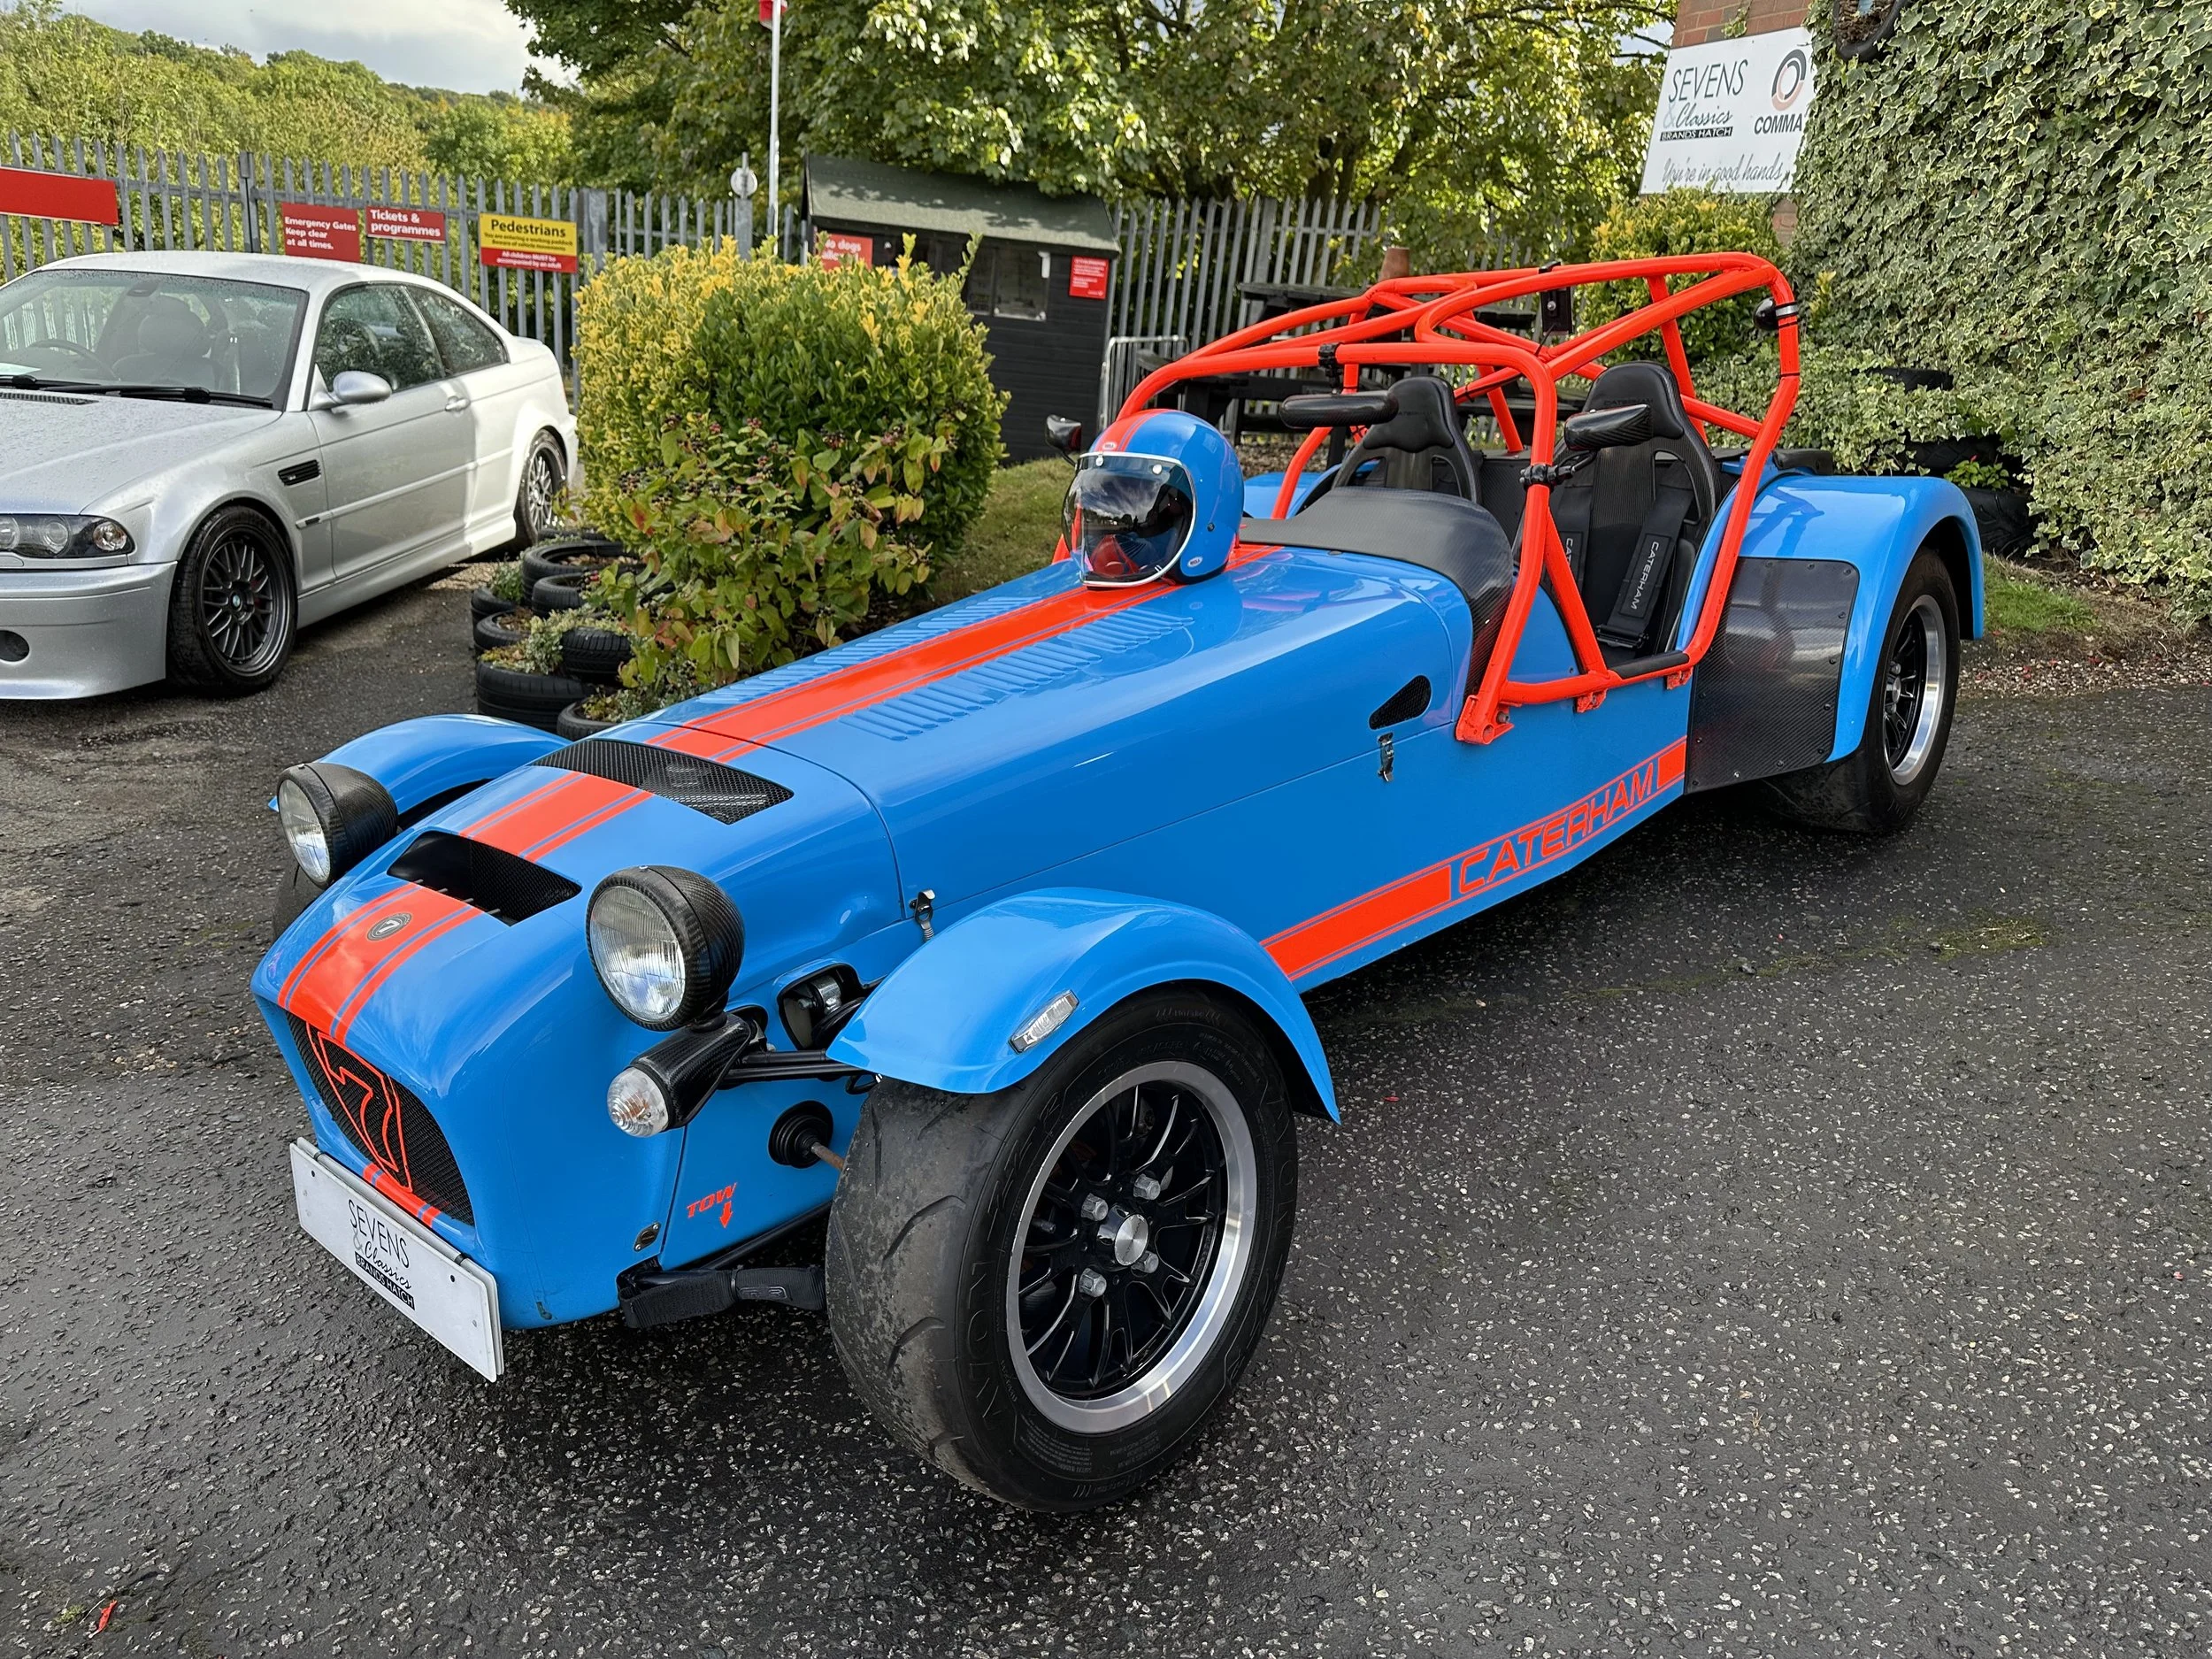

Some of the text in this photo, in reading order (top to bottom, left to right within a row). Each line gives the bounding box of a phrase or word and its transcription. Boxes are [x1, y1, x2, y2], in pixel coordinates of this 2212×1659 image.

[1669, 59, 1748, 103] SEVENS
[1661, 127, 1732, 141] BRANDS HATCH
[1754, 113, 1802, 134] COMMA
[1712, 153, 1746, 190] good
[284, 217, 356, 231] Emergency Gates
[370, 210, 419, 223] Tickets &
[285, 227, 327, 238] Keep clear
[371, 223, 441, 236] programmes
[491, 219, 566, 237] Pedestrians
[309, 240, 334, 250] times.
[838, 239, 862, 253] dogs
[1631, 541, 1659, 610] CATERHAM
[1459, 762, 1653, 894] CATERHAM
[687, 1182, 737, 1218] TOW
[349, 1199, 410, 1268] SEVENS
[365, 1240, 411, 1289] Classics
[357, 1256, 414, 1308] BRANDS HATCH
